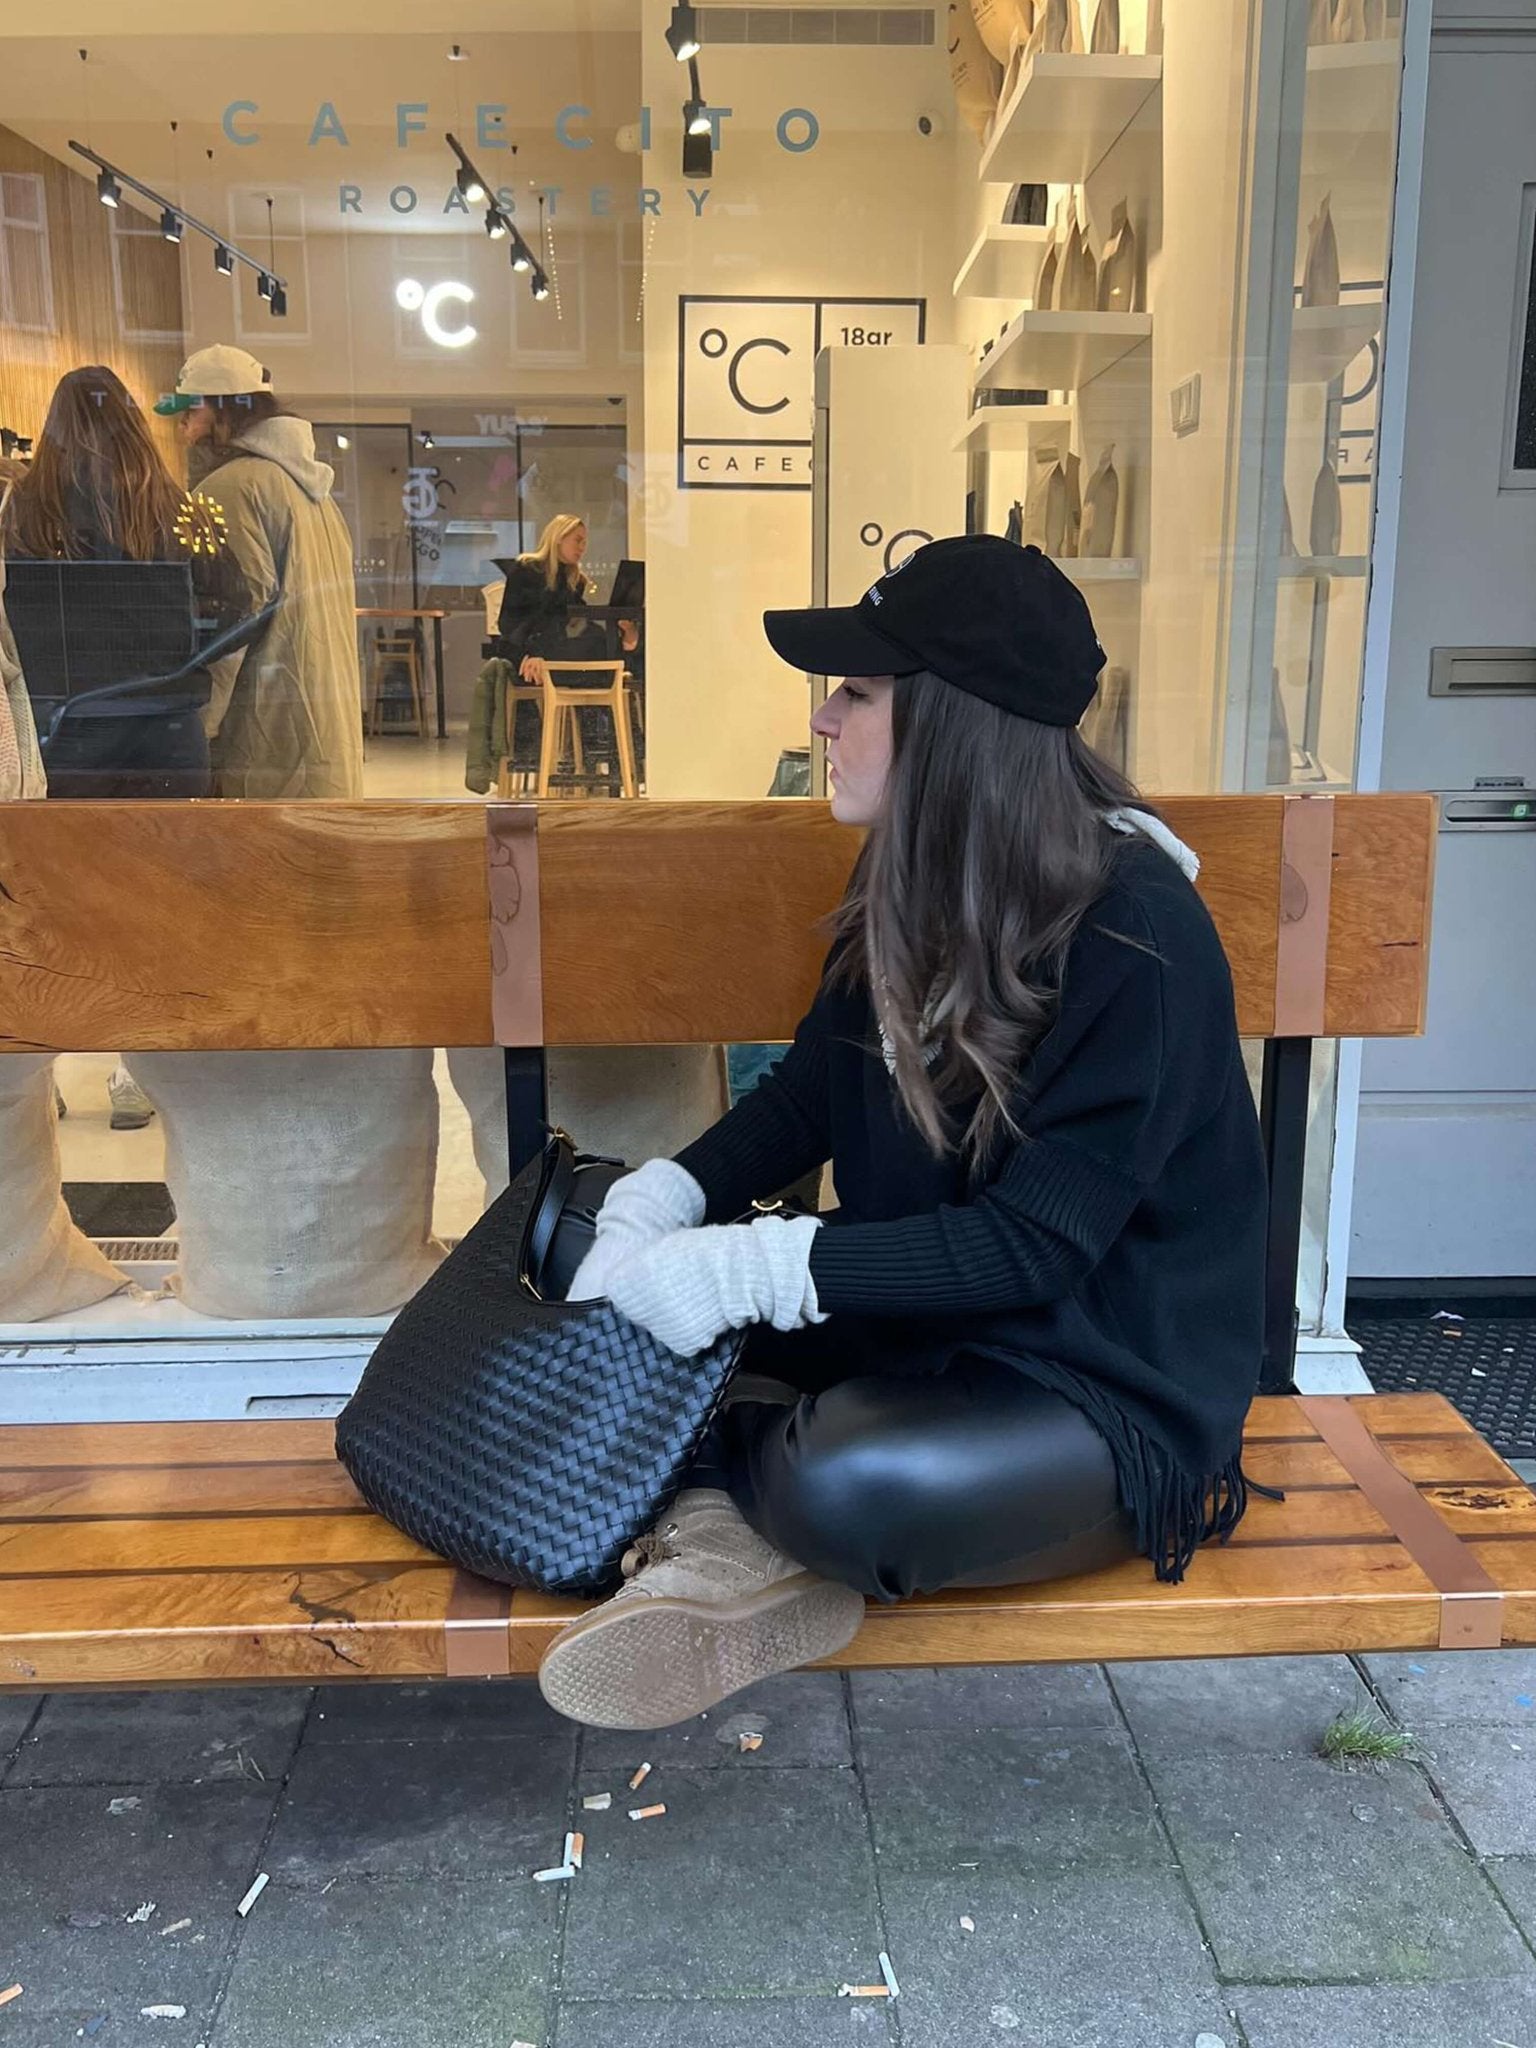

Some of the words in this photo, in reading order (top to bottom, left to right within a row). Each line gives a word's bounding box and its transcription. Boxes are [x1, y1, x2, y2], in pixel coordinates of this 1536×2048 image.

[222, 100, 820, 153] CAFECITO
[338, 184, 711, 217] ROASTERY
[697, 455, 812, 472] CAFE
